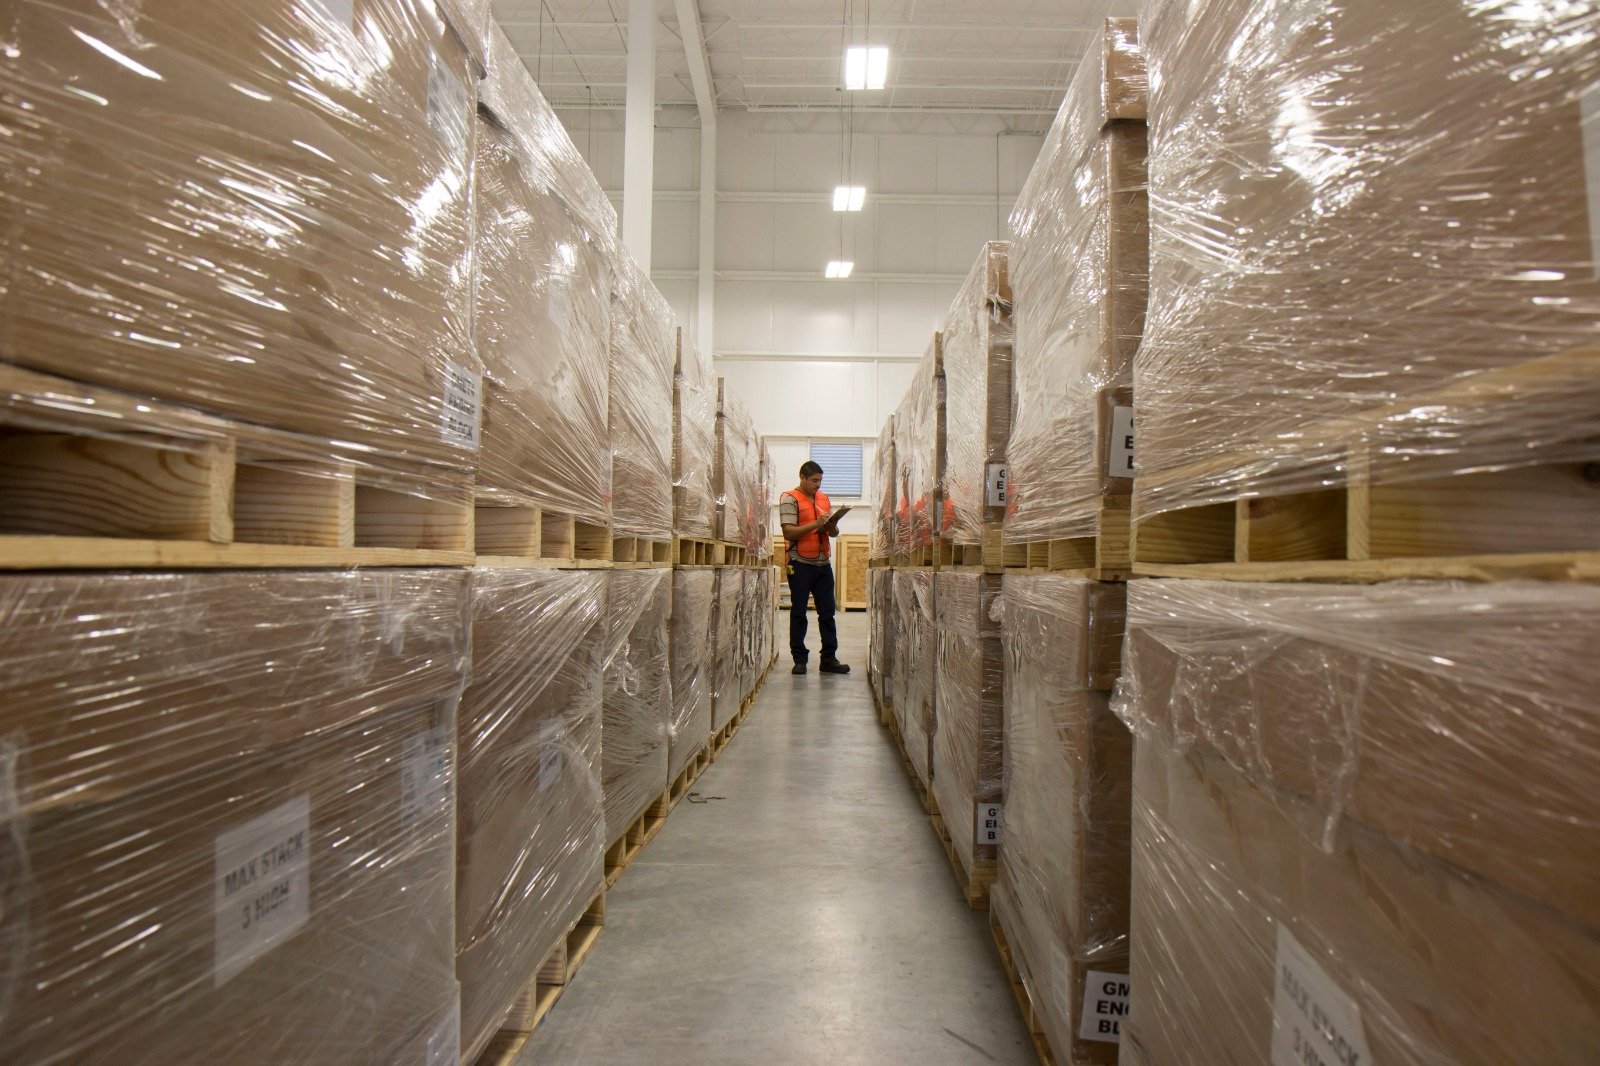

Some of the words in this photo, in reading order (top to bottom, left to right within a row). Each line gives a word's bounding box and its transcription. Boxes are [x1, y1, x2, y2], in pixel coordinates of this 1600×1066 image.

[224, 856, 258, 898] MAX
[261, 830, 304, 878] STACK
[242, 904, 251, 930] 3
[255, 878, 290, 923] HIGH
[1281, 964, 1310, 1019] MAX
[1293, 1026, 1301, 1054] 3
